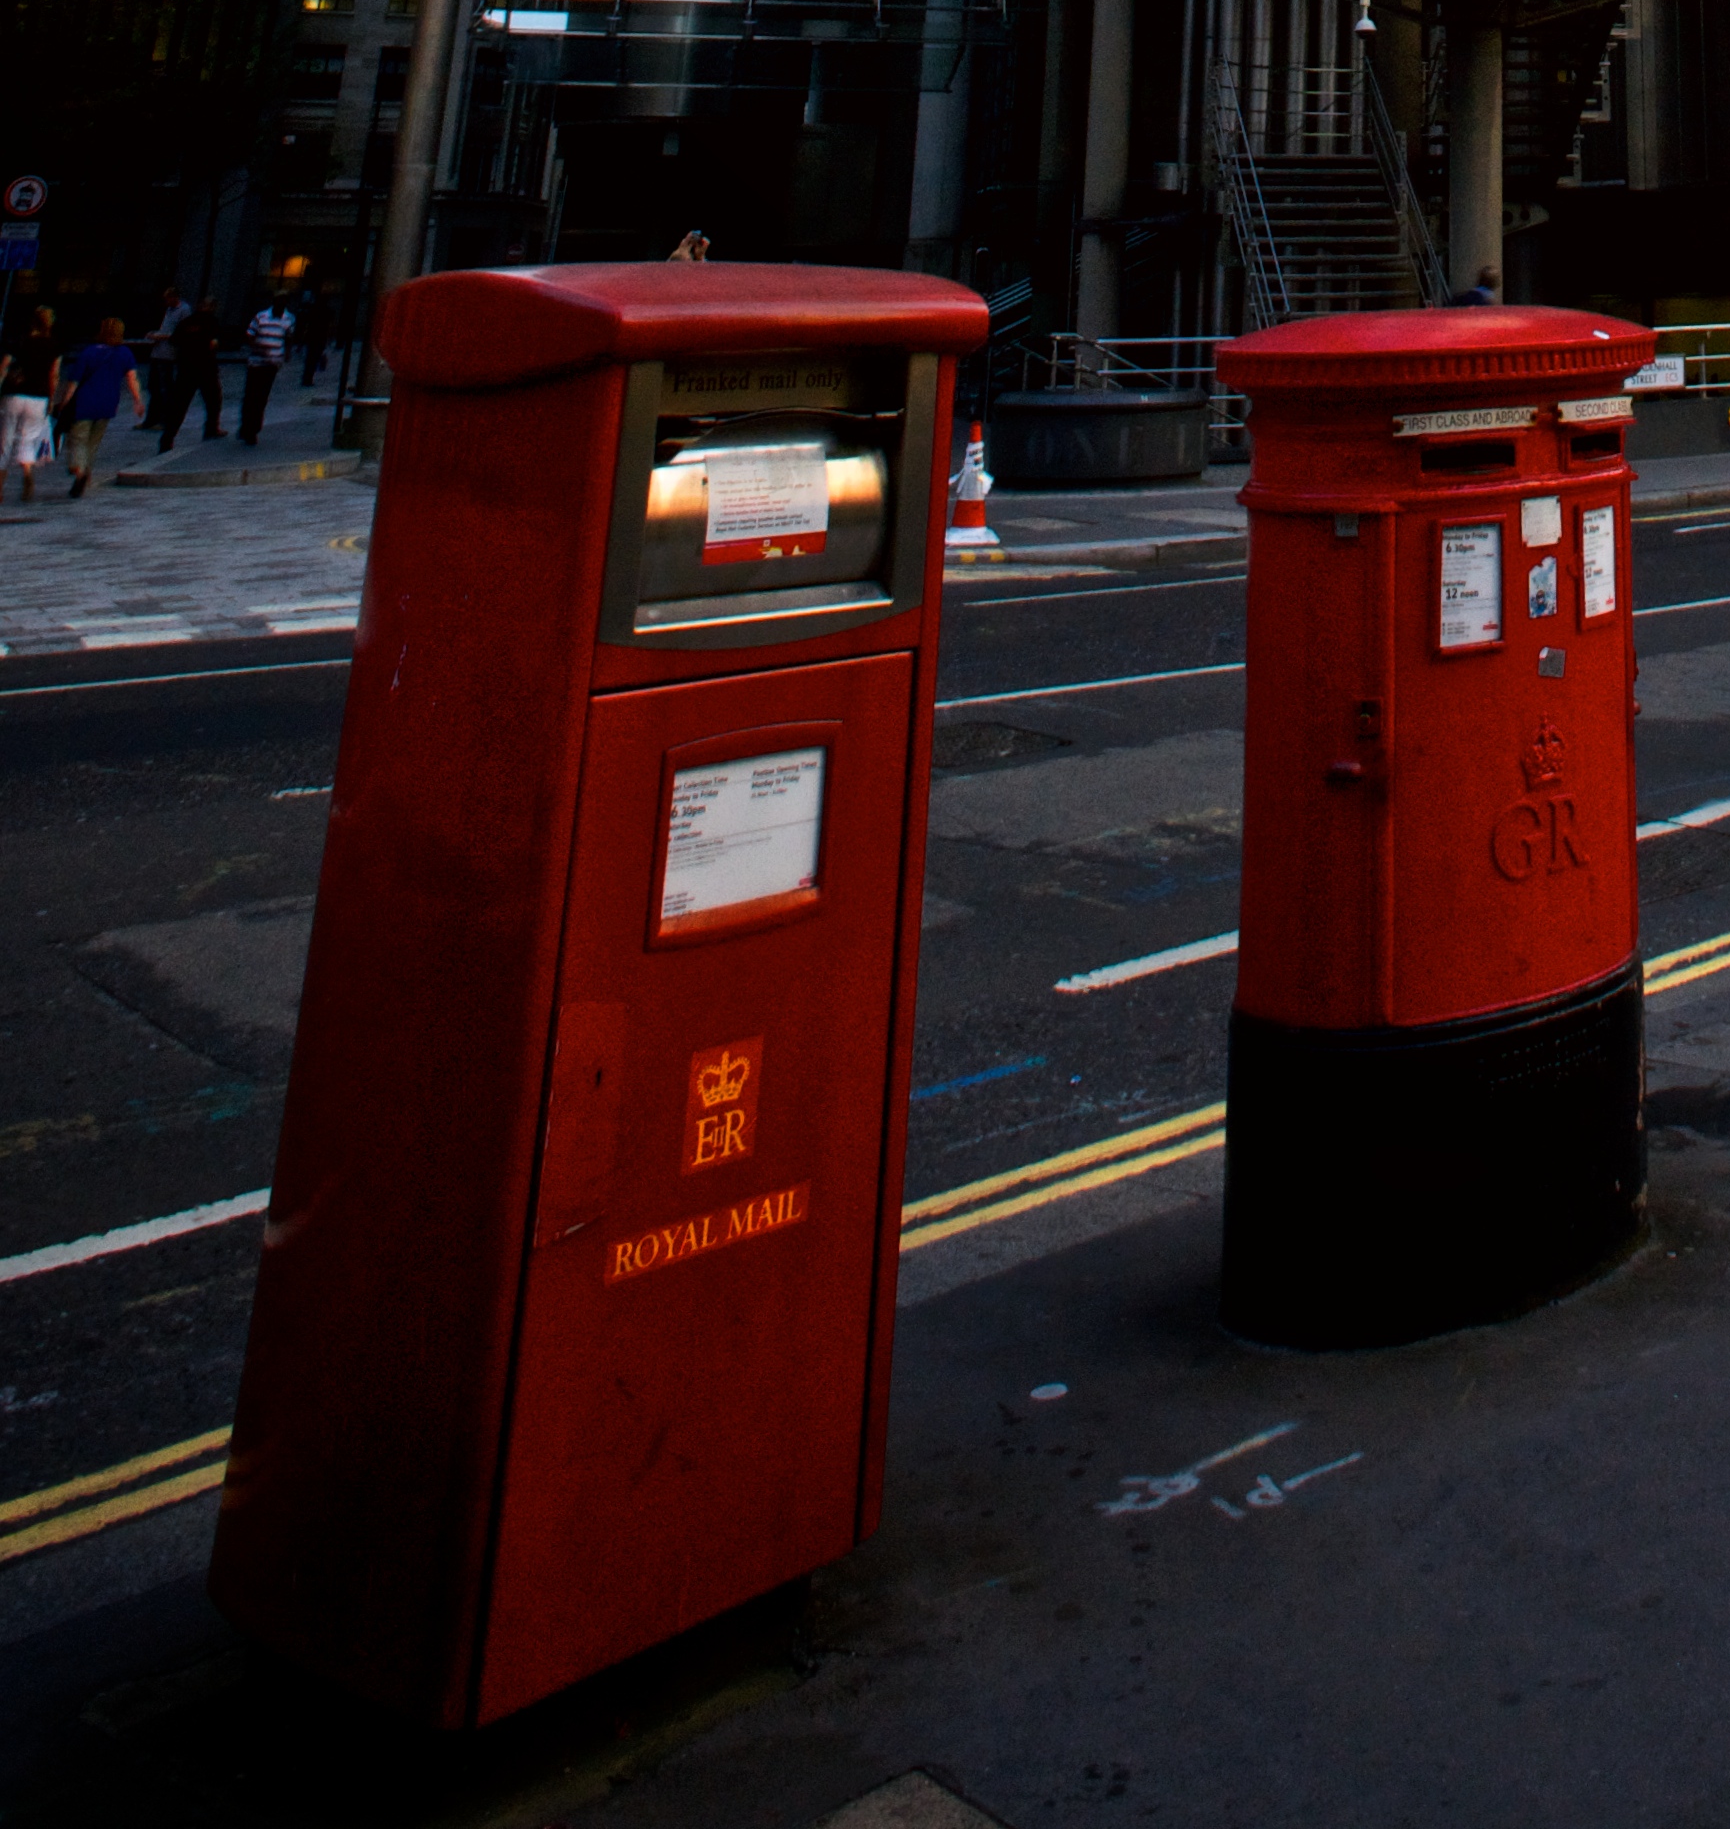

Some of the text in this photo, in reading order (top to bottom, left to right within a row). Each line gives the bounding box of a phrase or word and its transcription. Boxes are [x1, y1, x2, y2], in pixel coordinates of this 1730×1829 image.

[673, 367, 843, 392] Franked mail only
[1630, 372, 1679, 385] STREET EC3
[1575, 402, 1609, 418] SECOND
[1403, 409, 1532, 430] FIRST CLASS AND ABROAD
[1445, 587, 1479, 600] 12 noon
[612, 1190, 802, 1277] ROYAL MAIL
